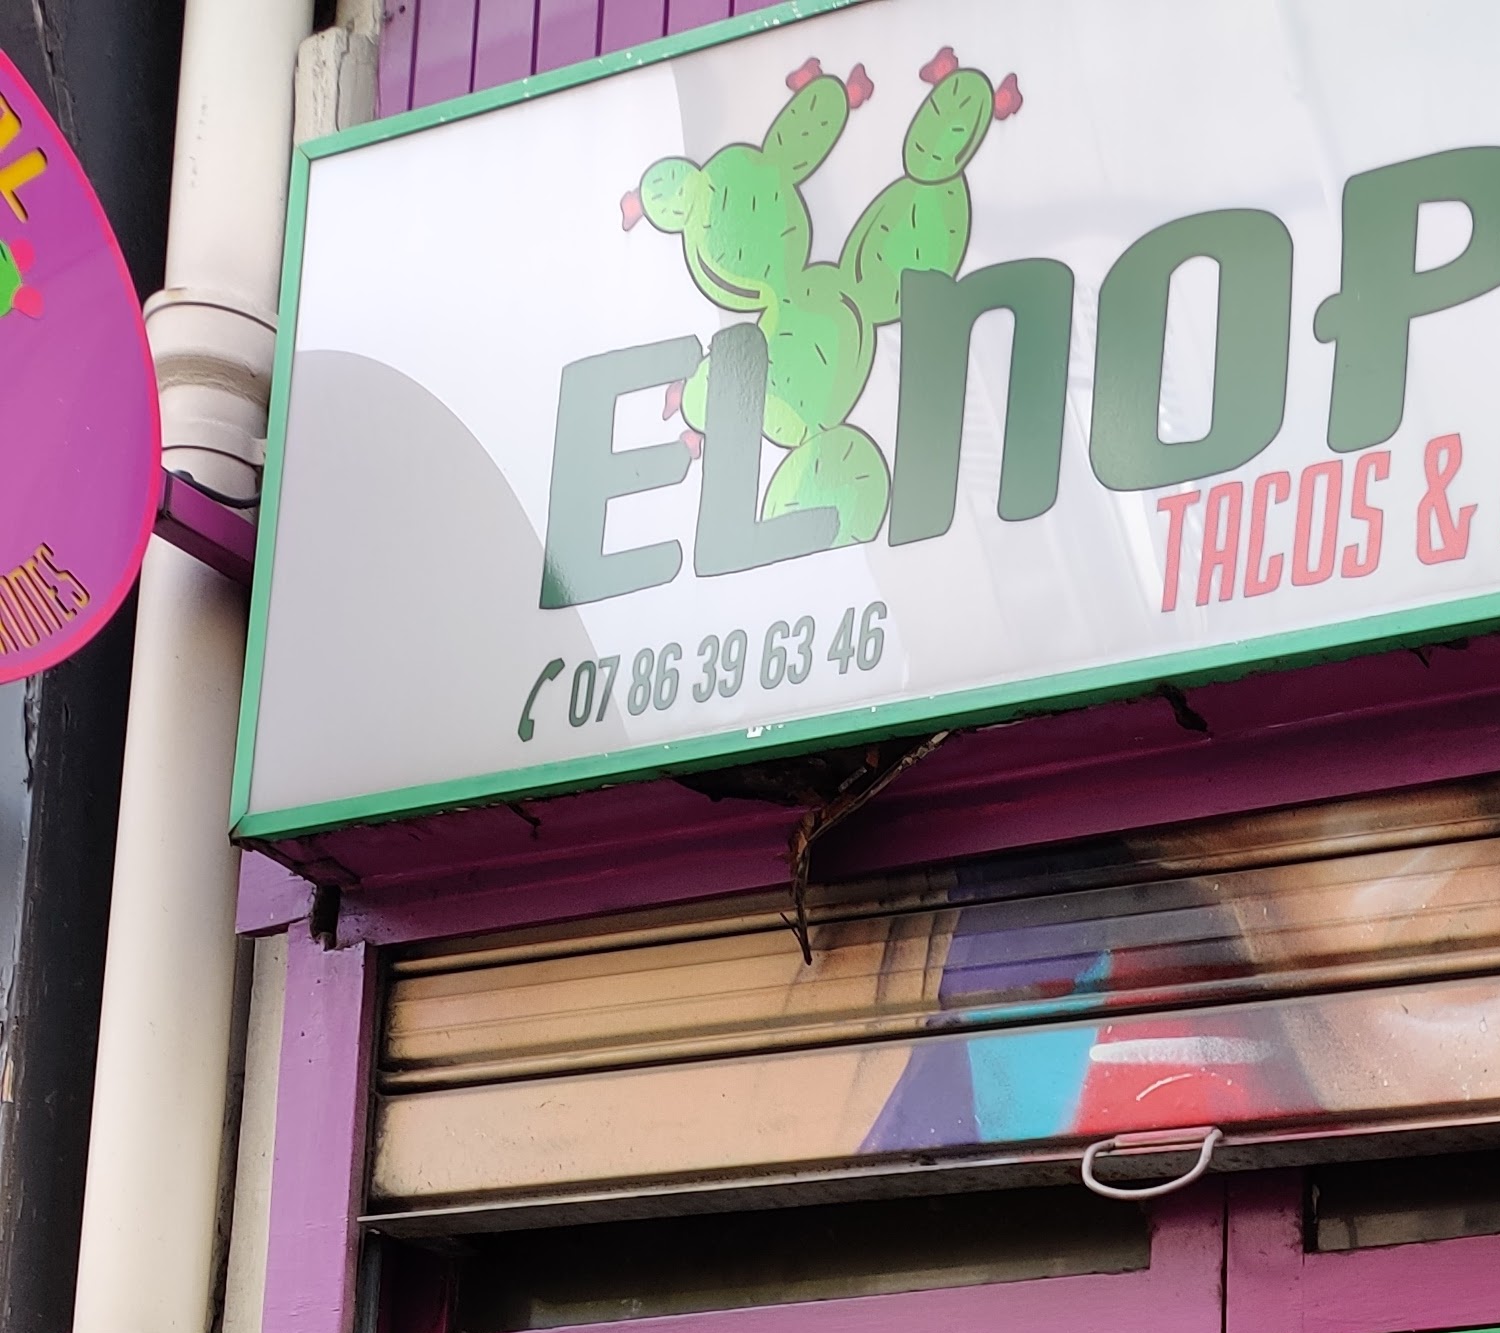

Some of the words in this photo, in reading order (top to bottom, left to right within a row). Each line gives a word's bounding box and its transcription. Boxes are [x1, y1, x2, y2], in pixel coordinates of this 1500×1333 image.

[539, 322, 842, 611] EL
[1156, 450, 1391, 613] TACOS
[1414, 432, 1478, 565] &
[568, 654, 619, 727] 07
[628, 643, 679, 717] 86
[692, 629, 749, 702] 39
[758, 612, 815, 690] 63
[827, 600, 888, 677] 46
